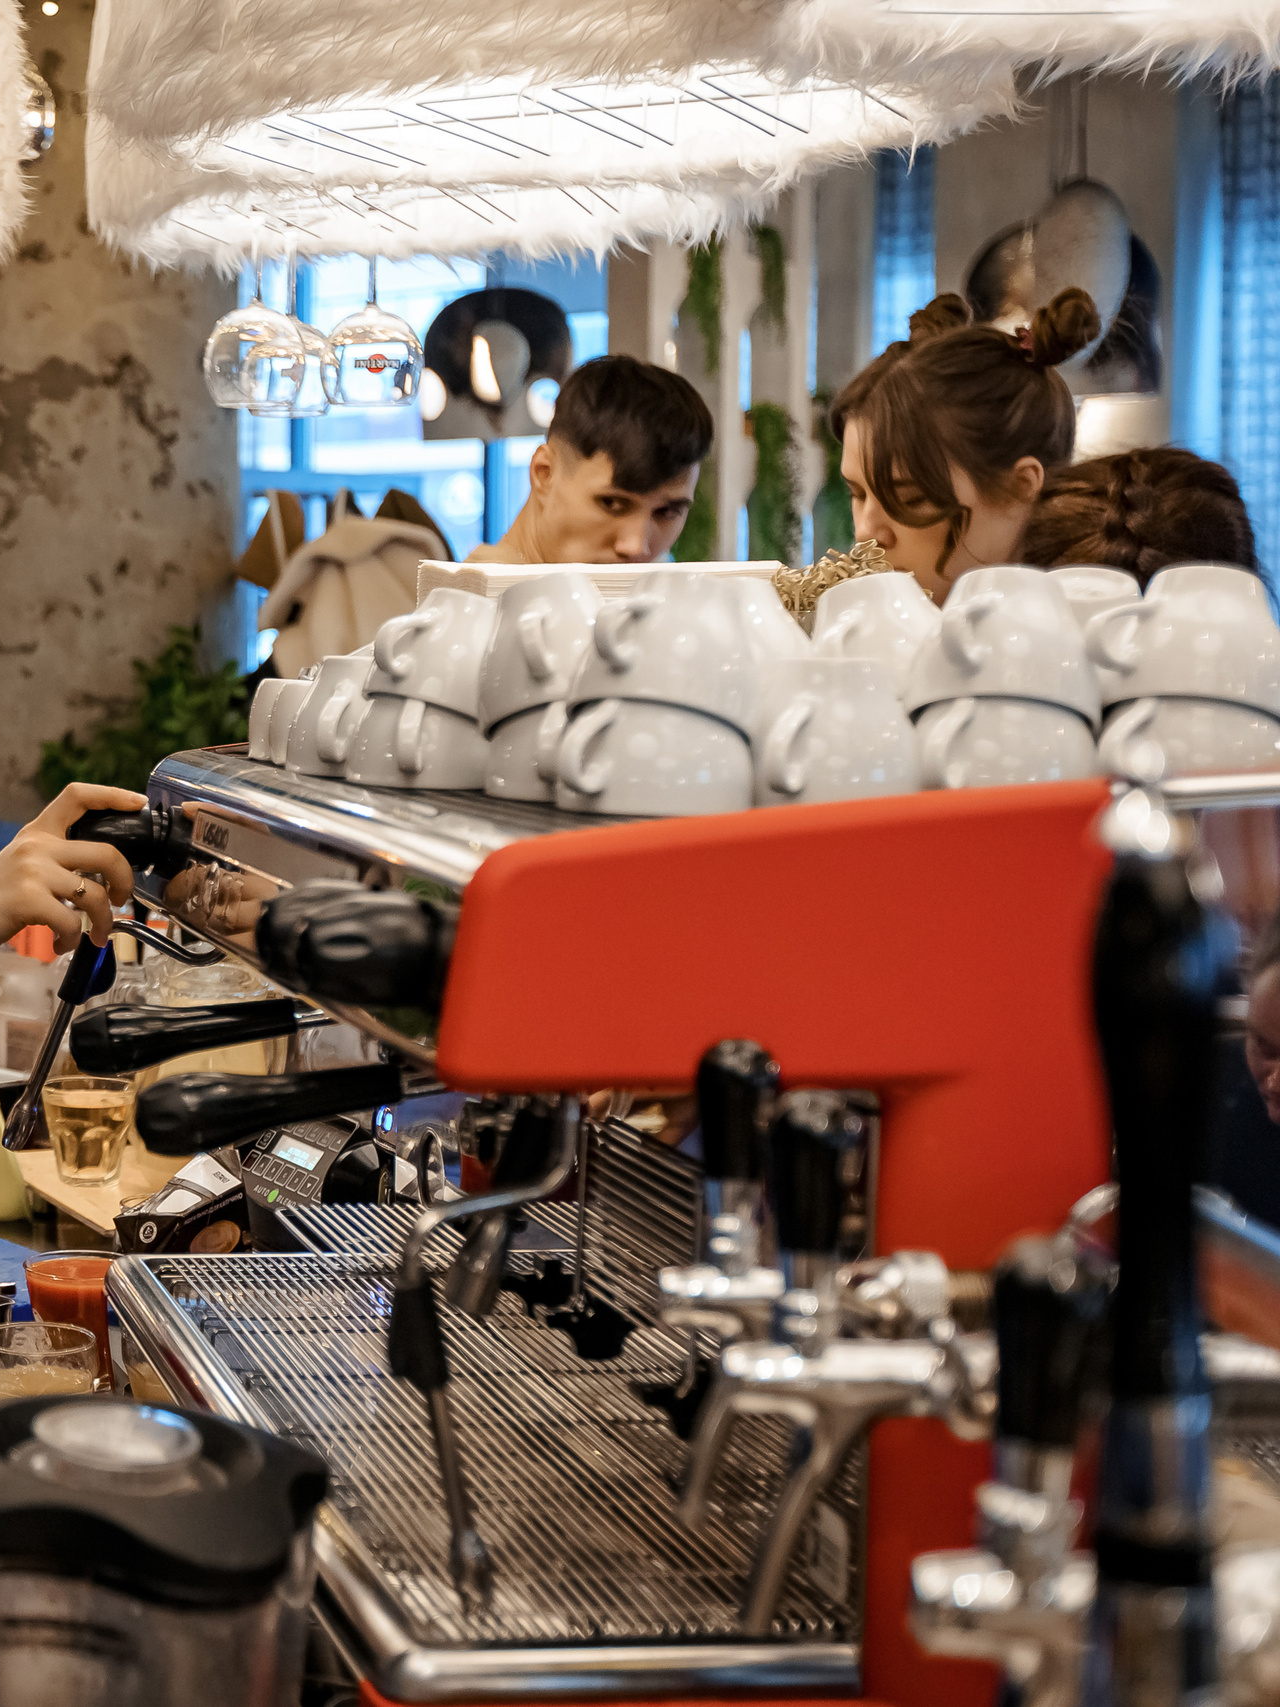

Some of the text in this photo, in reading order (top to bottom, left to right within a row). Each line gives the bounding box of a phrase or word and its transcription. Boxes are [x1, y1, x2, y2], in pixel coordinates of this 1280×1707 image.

[355, 359, 400, 369] MARTINI
[253, 1185, 297, 1208] AUTO BLEND
